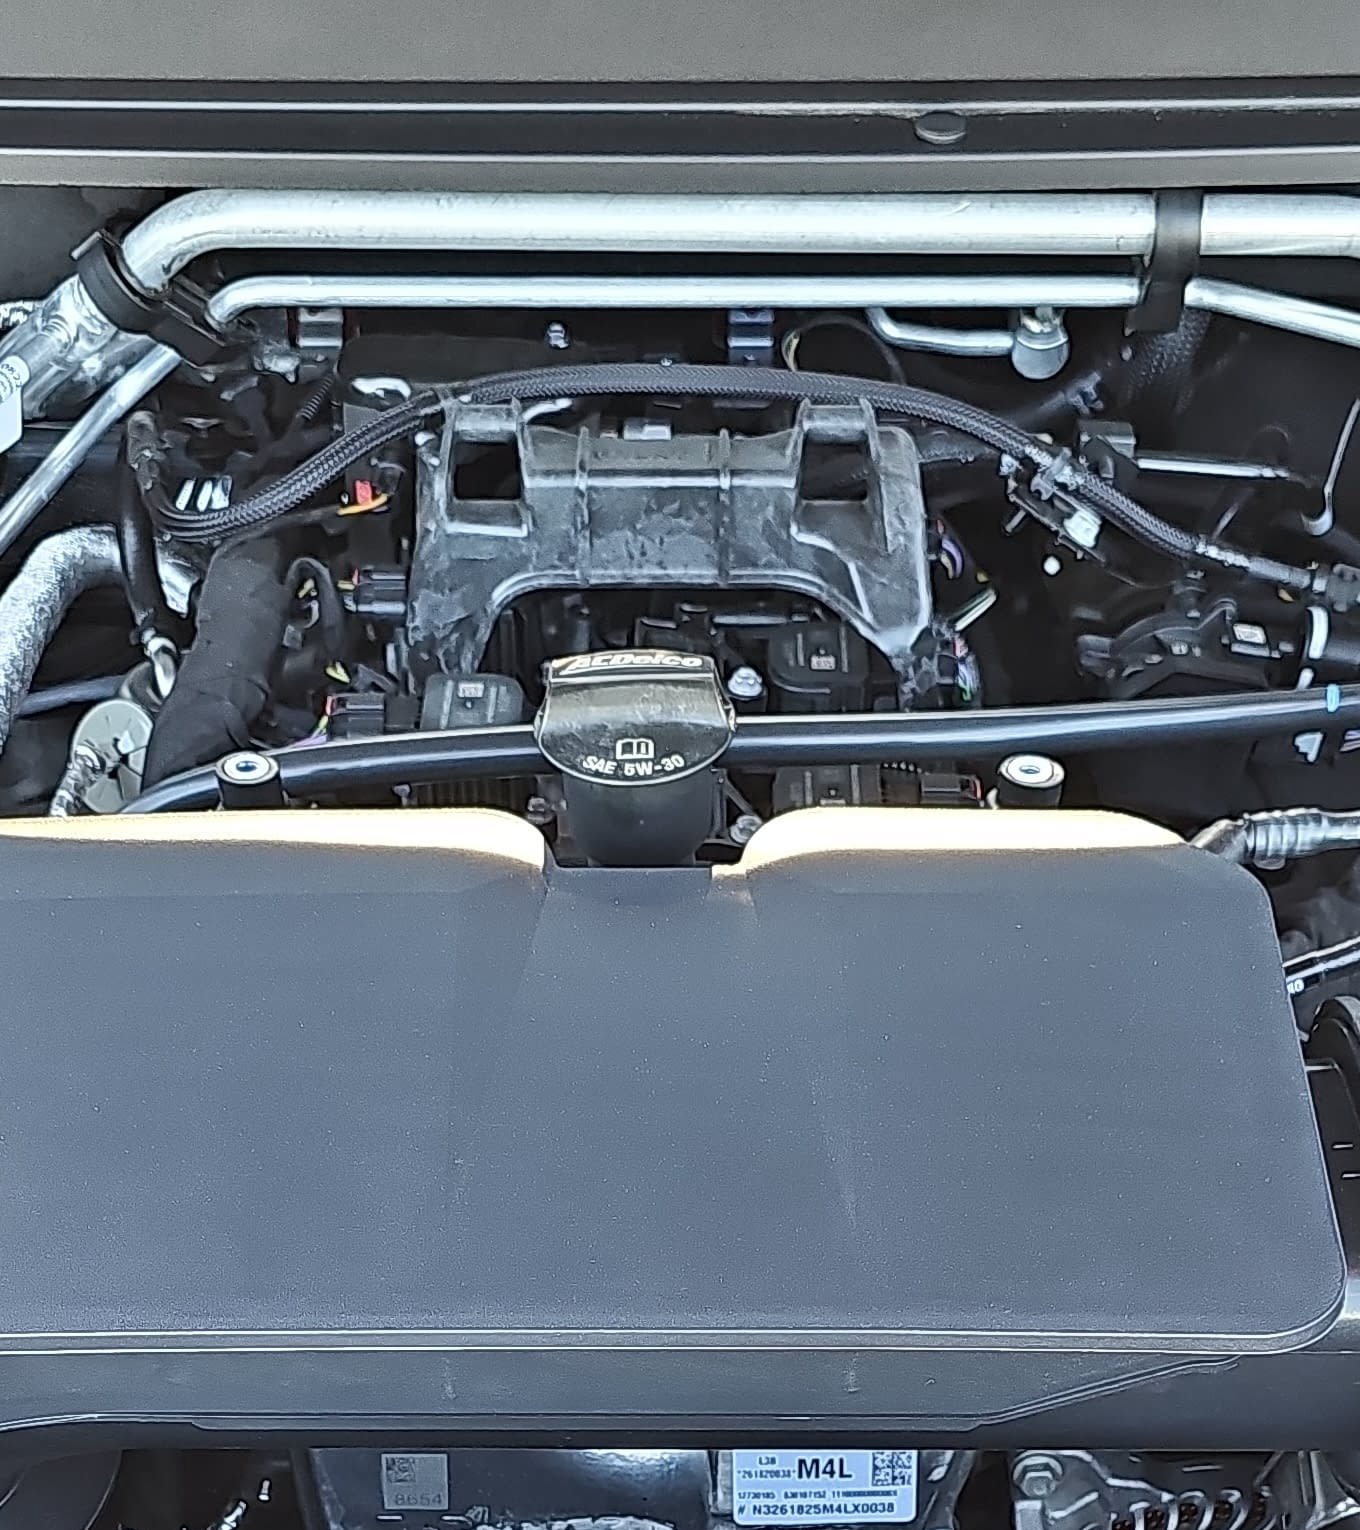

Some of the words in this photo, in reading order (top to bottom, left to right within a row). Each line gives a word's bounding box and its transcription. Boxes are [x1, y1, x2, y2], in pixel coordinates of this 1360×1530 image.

[567, 653, 703, 673] ACDelco
[582, 755, 618, 775] SAE
[623, 754, 685, 776] 5W-30
[797, 1457, 853, 1480] M4L
